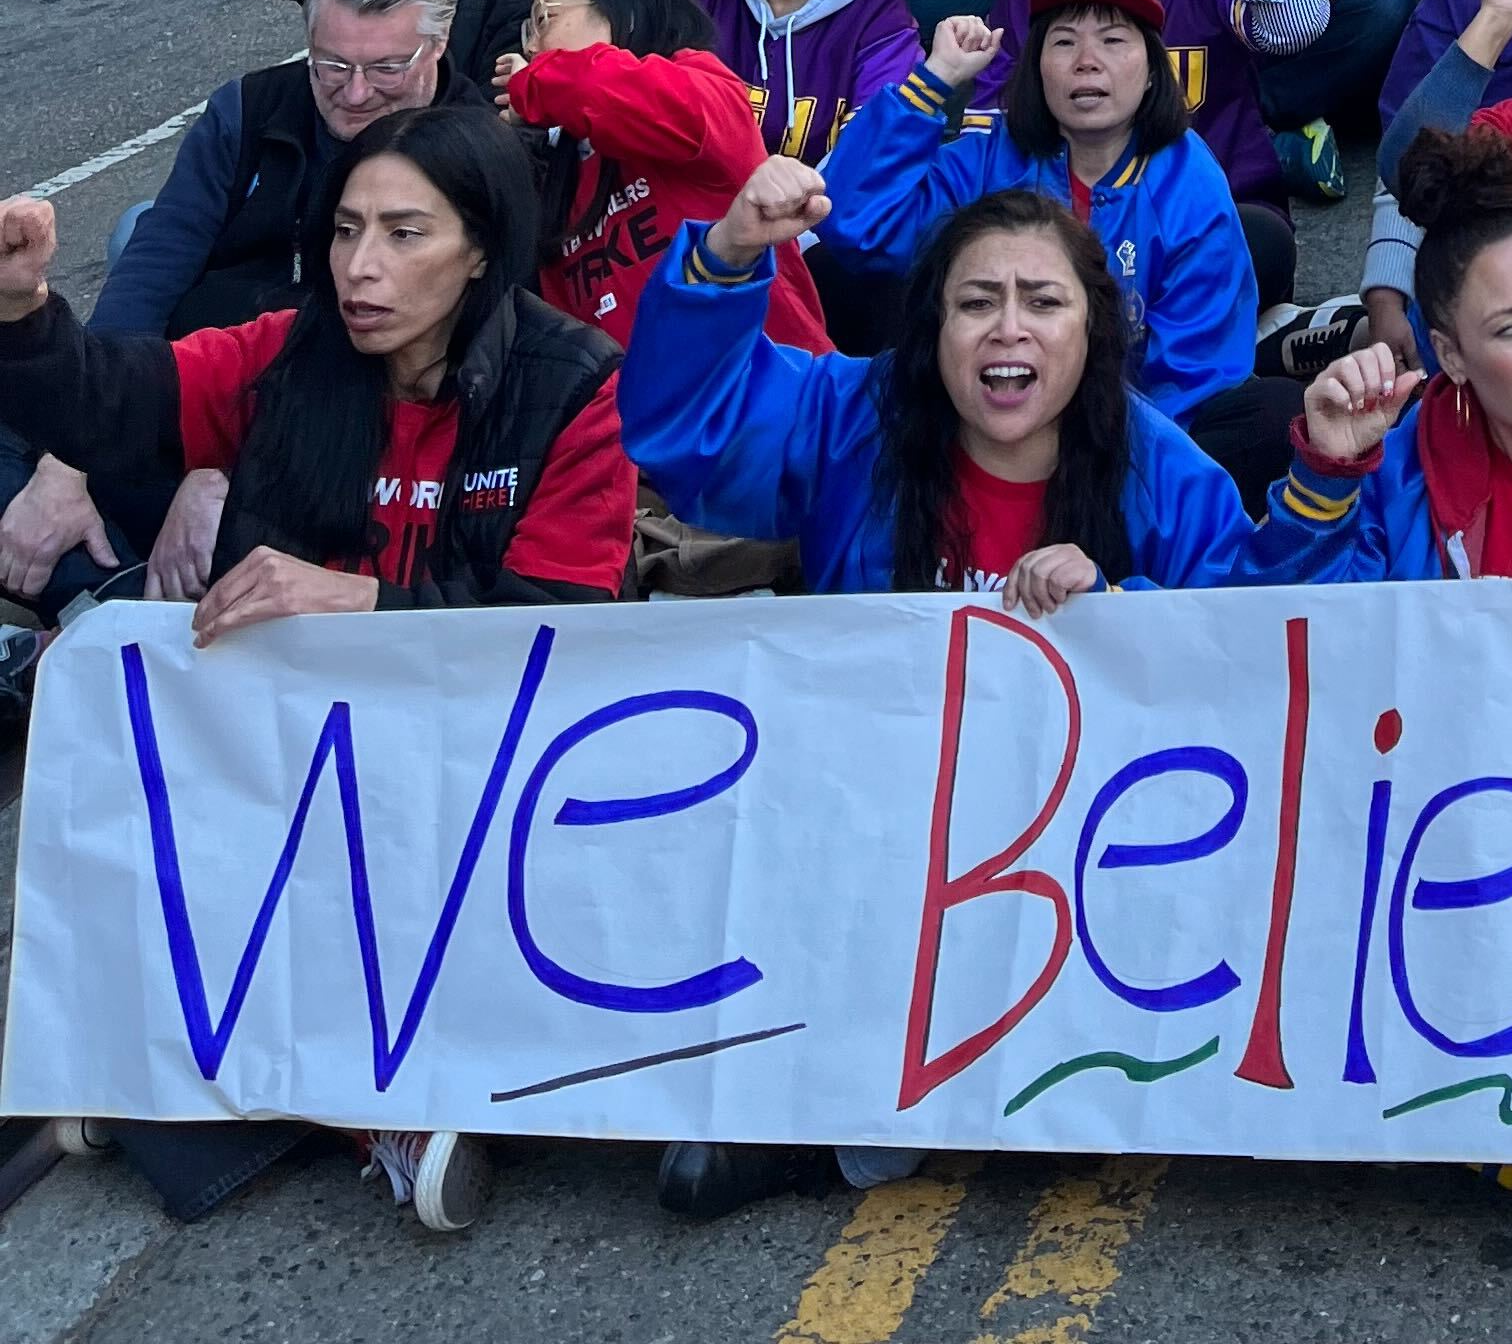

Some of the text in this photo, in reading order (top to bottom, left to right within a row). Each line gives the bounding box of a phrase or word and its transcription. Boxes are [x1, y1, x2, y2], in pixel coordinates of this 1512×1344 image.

[463, 467, 519, 493] UNITE
[462, 486, 516, 510] HERE!
[121, 625, 763, 1093] We
